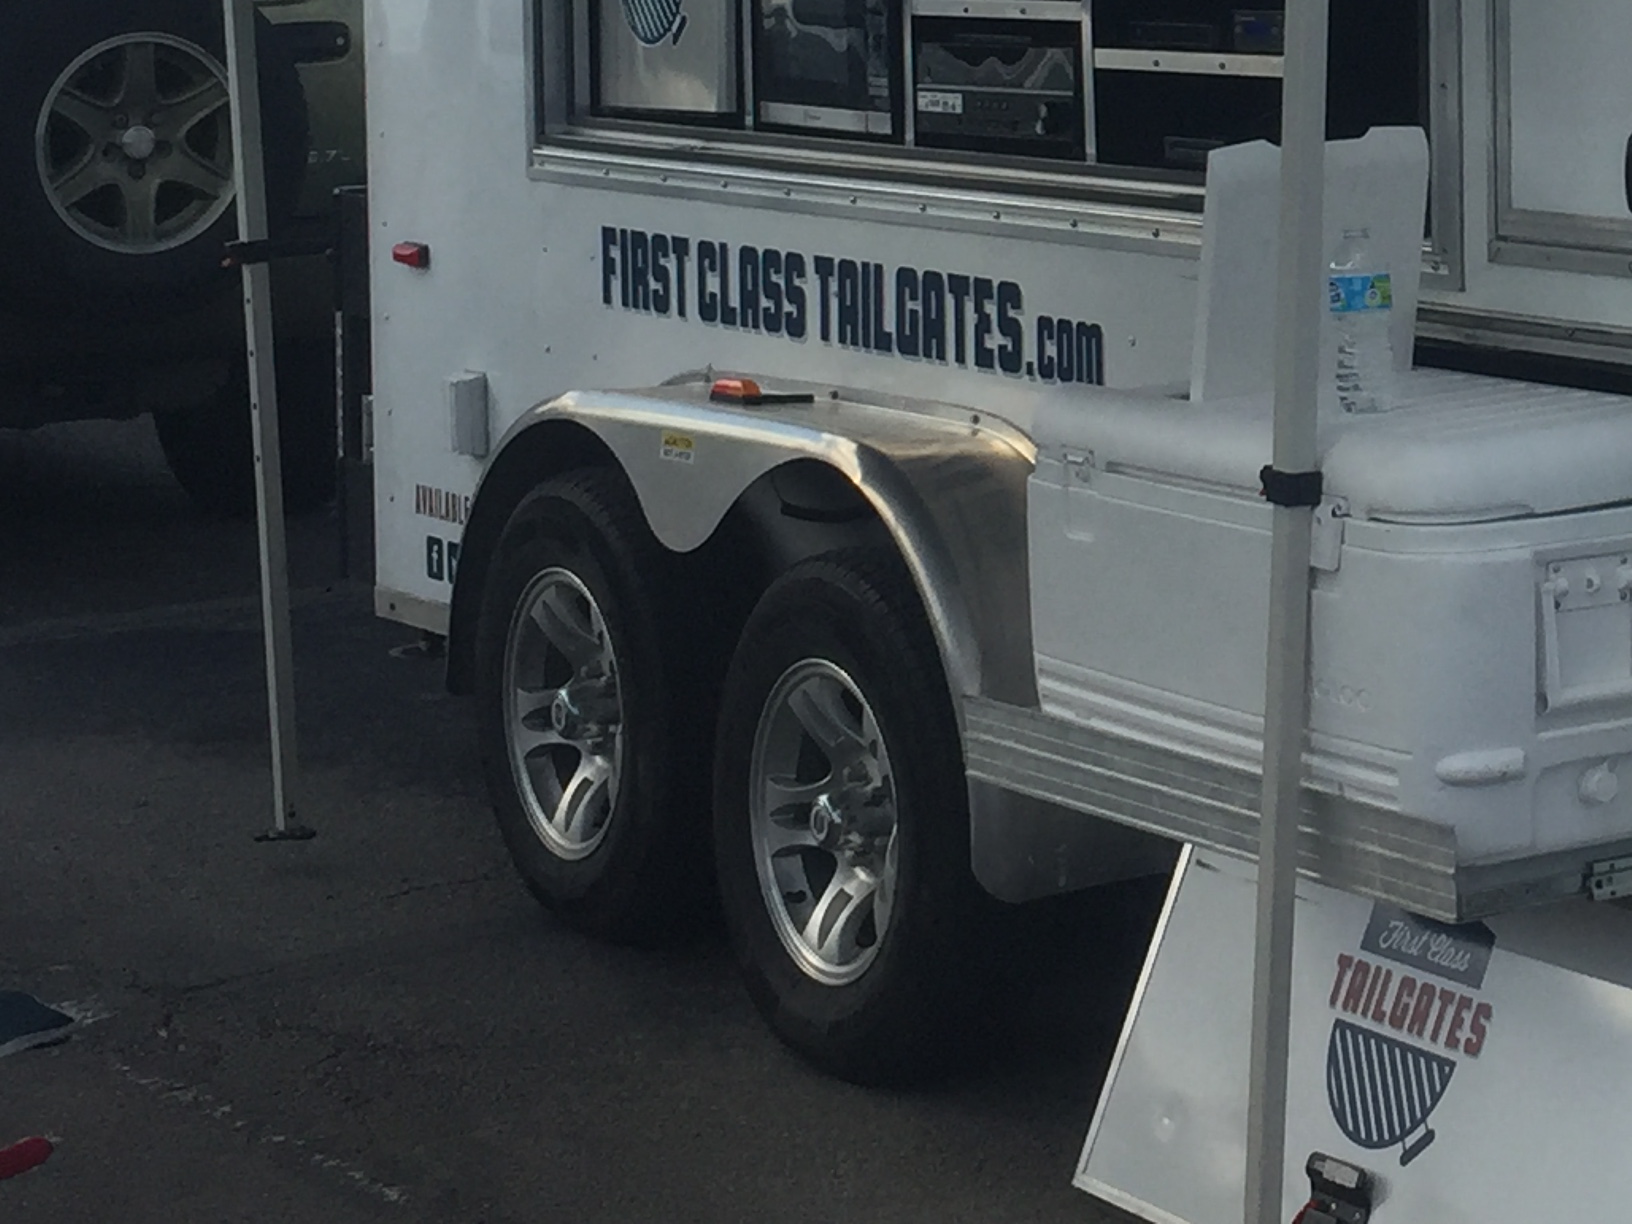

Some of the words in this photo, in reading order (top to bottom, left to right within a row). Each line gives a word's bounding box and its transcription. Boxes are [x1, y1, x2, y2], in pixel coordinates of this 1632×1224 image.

[1378, 920, 1430, 957] First
[1426, 930, 1473, 973] Class
[1329, 953, 1494, 1060] TAILGATES
